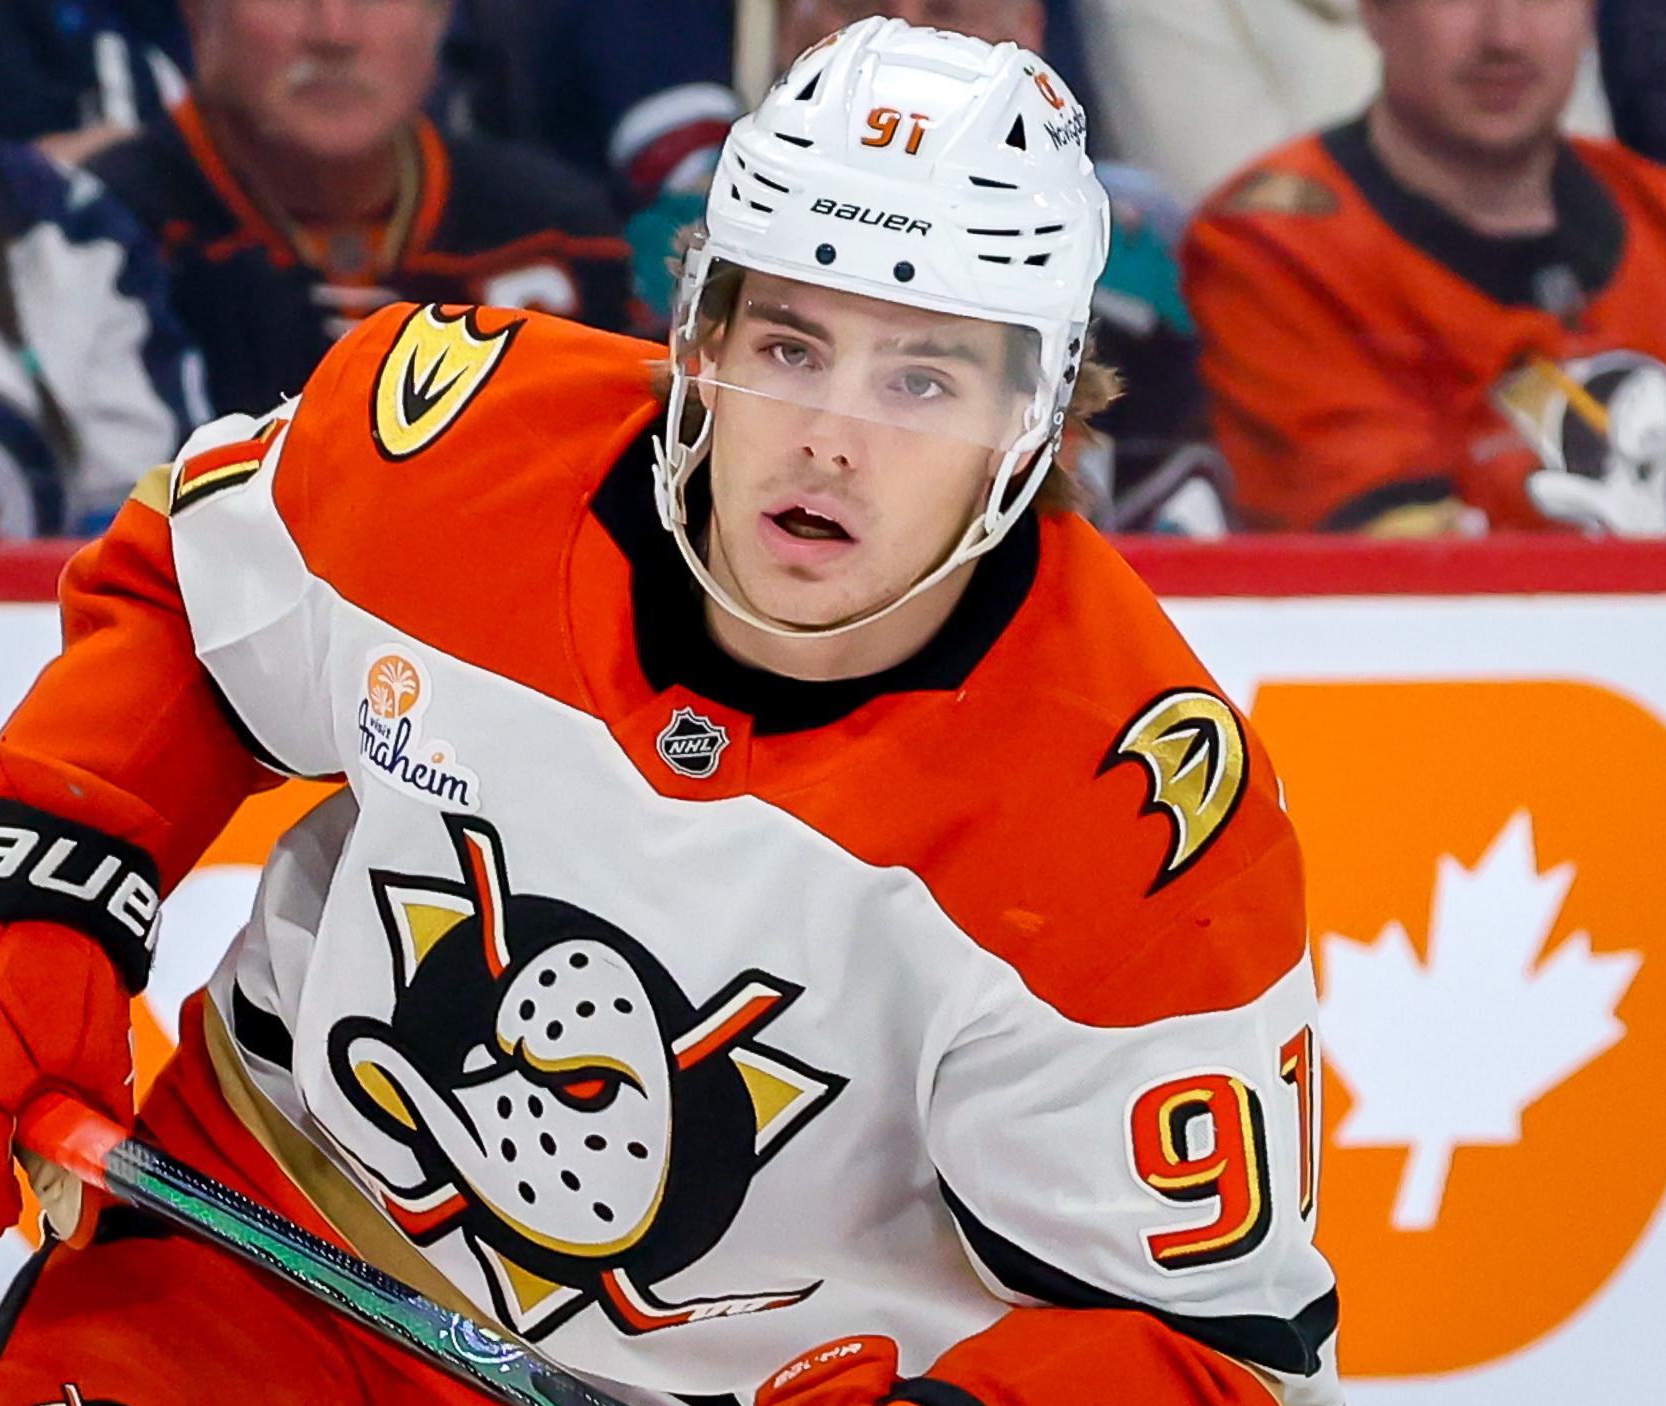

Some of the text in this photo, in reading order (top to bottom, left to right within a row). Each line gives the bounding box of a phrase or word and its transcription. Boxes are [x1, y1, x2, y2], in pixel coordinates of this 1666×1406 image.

[860, 106, 933, 156] 91
[810, 198, 933, 237] BAUER
[369, 716, 392, 740] visit
[668, 738, 712, 754] NHL
[1125, 1022, 1316, 1275] 91
